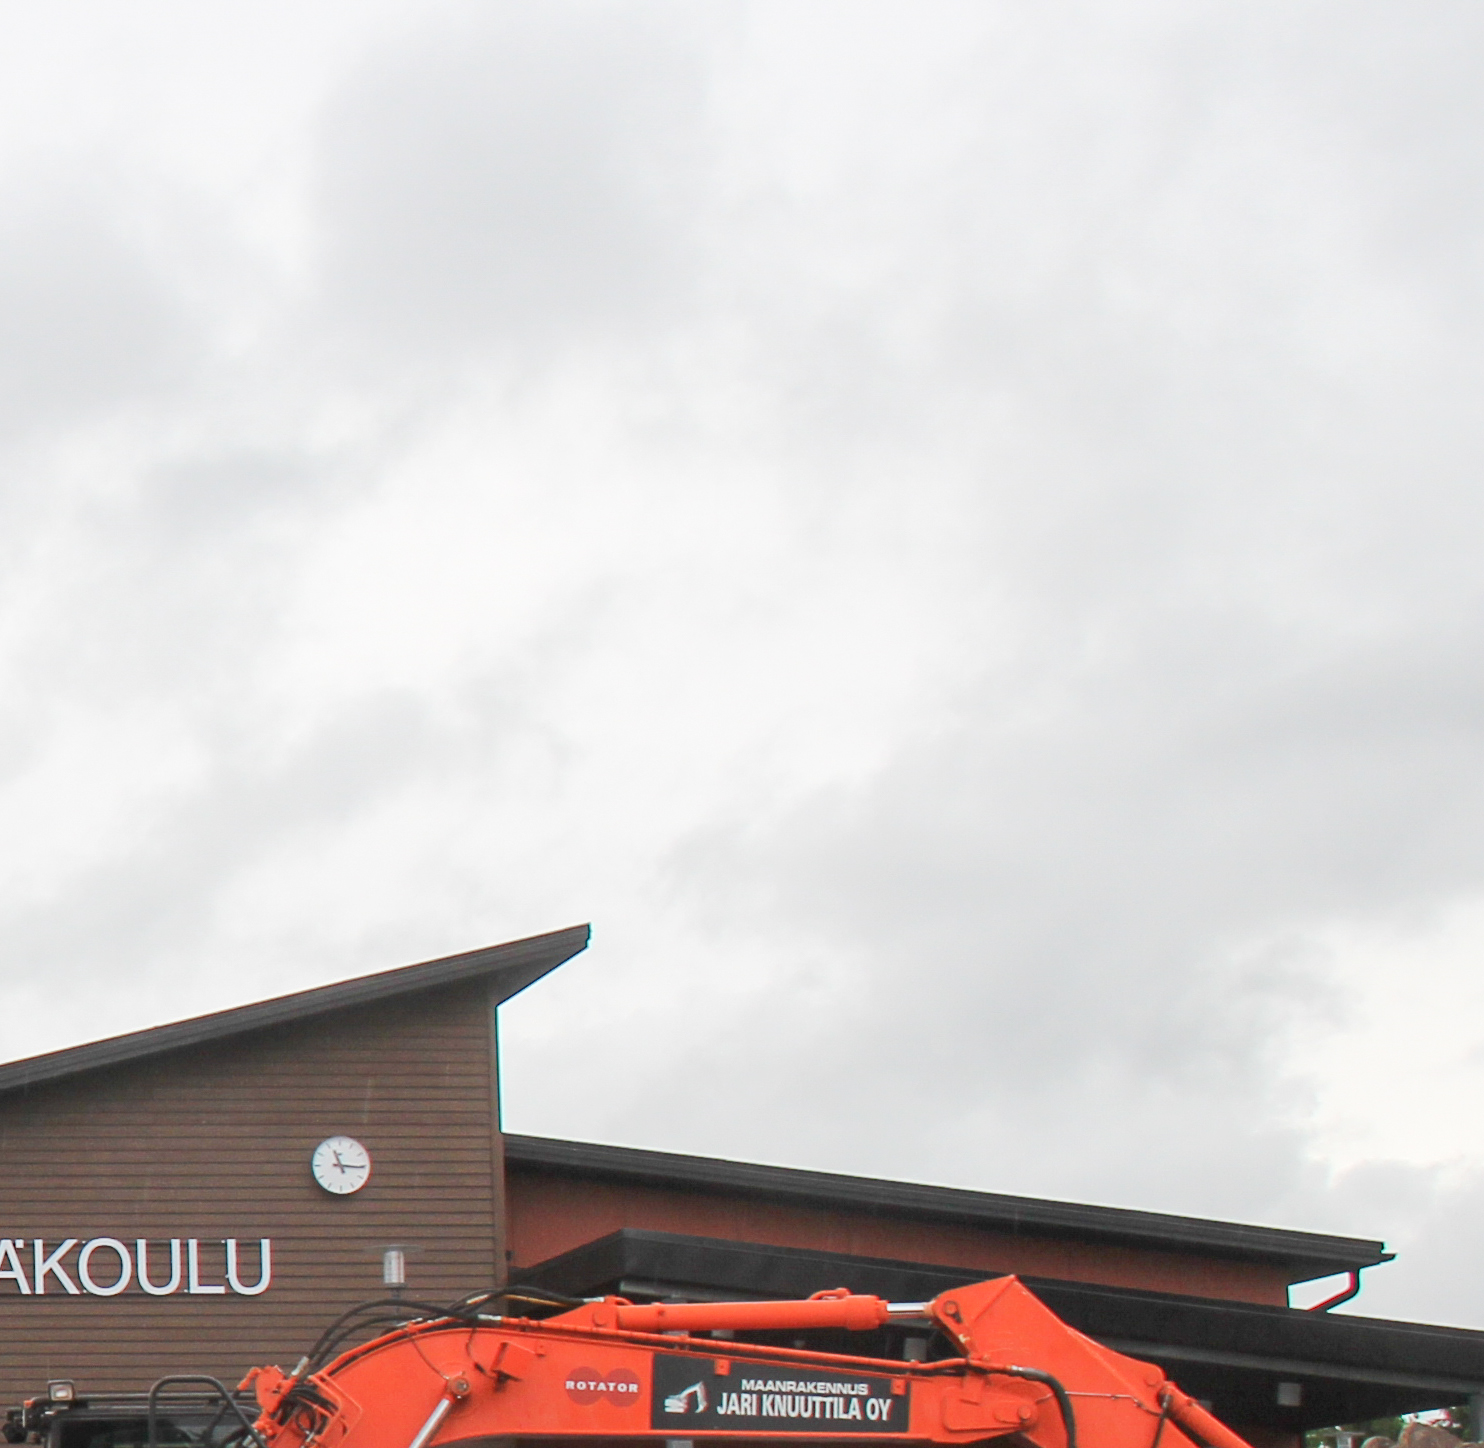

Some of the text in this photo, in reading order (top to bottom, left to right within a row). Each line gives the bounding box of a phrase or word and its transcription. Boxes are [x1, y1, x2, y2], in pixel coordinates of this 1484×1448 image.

[565, 1380, 638, 1393] ROTATOR
[741, 1378, 870, 1395] MAANRAKENNUS
[716, 1392, 892, 1421] JARI KNUUTTILA OY
